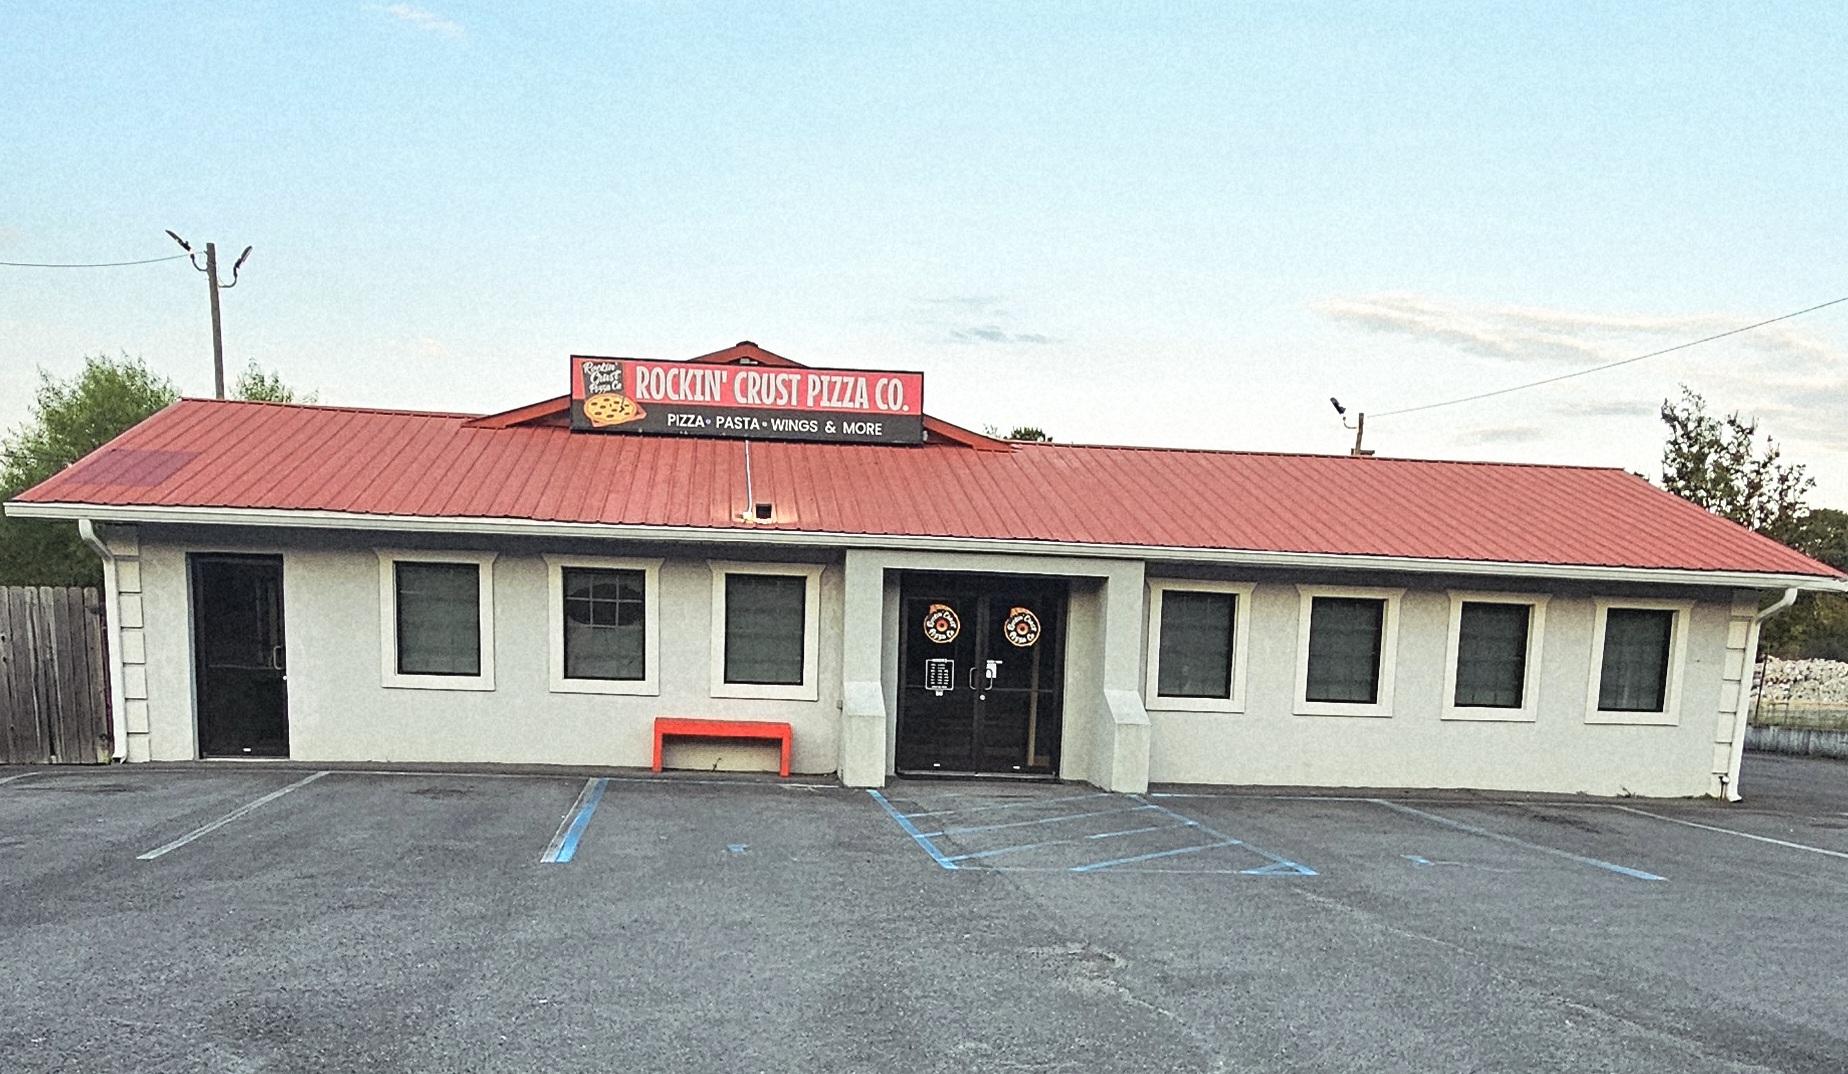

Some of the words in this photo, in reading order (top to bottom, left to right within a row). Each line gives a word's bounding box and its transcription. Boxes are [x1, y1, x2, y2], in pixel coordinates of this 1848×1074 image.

[636, 366, 727, 401] ROCKIN'
[734, 371, 801, 406] CRUST
[807, 374, 869, 409] PIZZA
[875, 377, 910, 412] CO.
[667, 413, 705, 428] PIZZA
[716, 416, 760, 430] PASTA
[770, 417, 818, 433] WINGS
[825, 420, 836, 434] &
[843, 421, 883, 436] MORE
